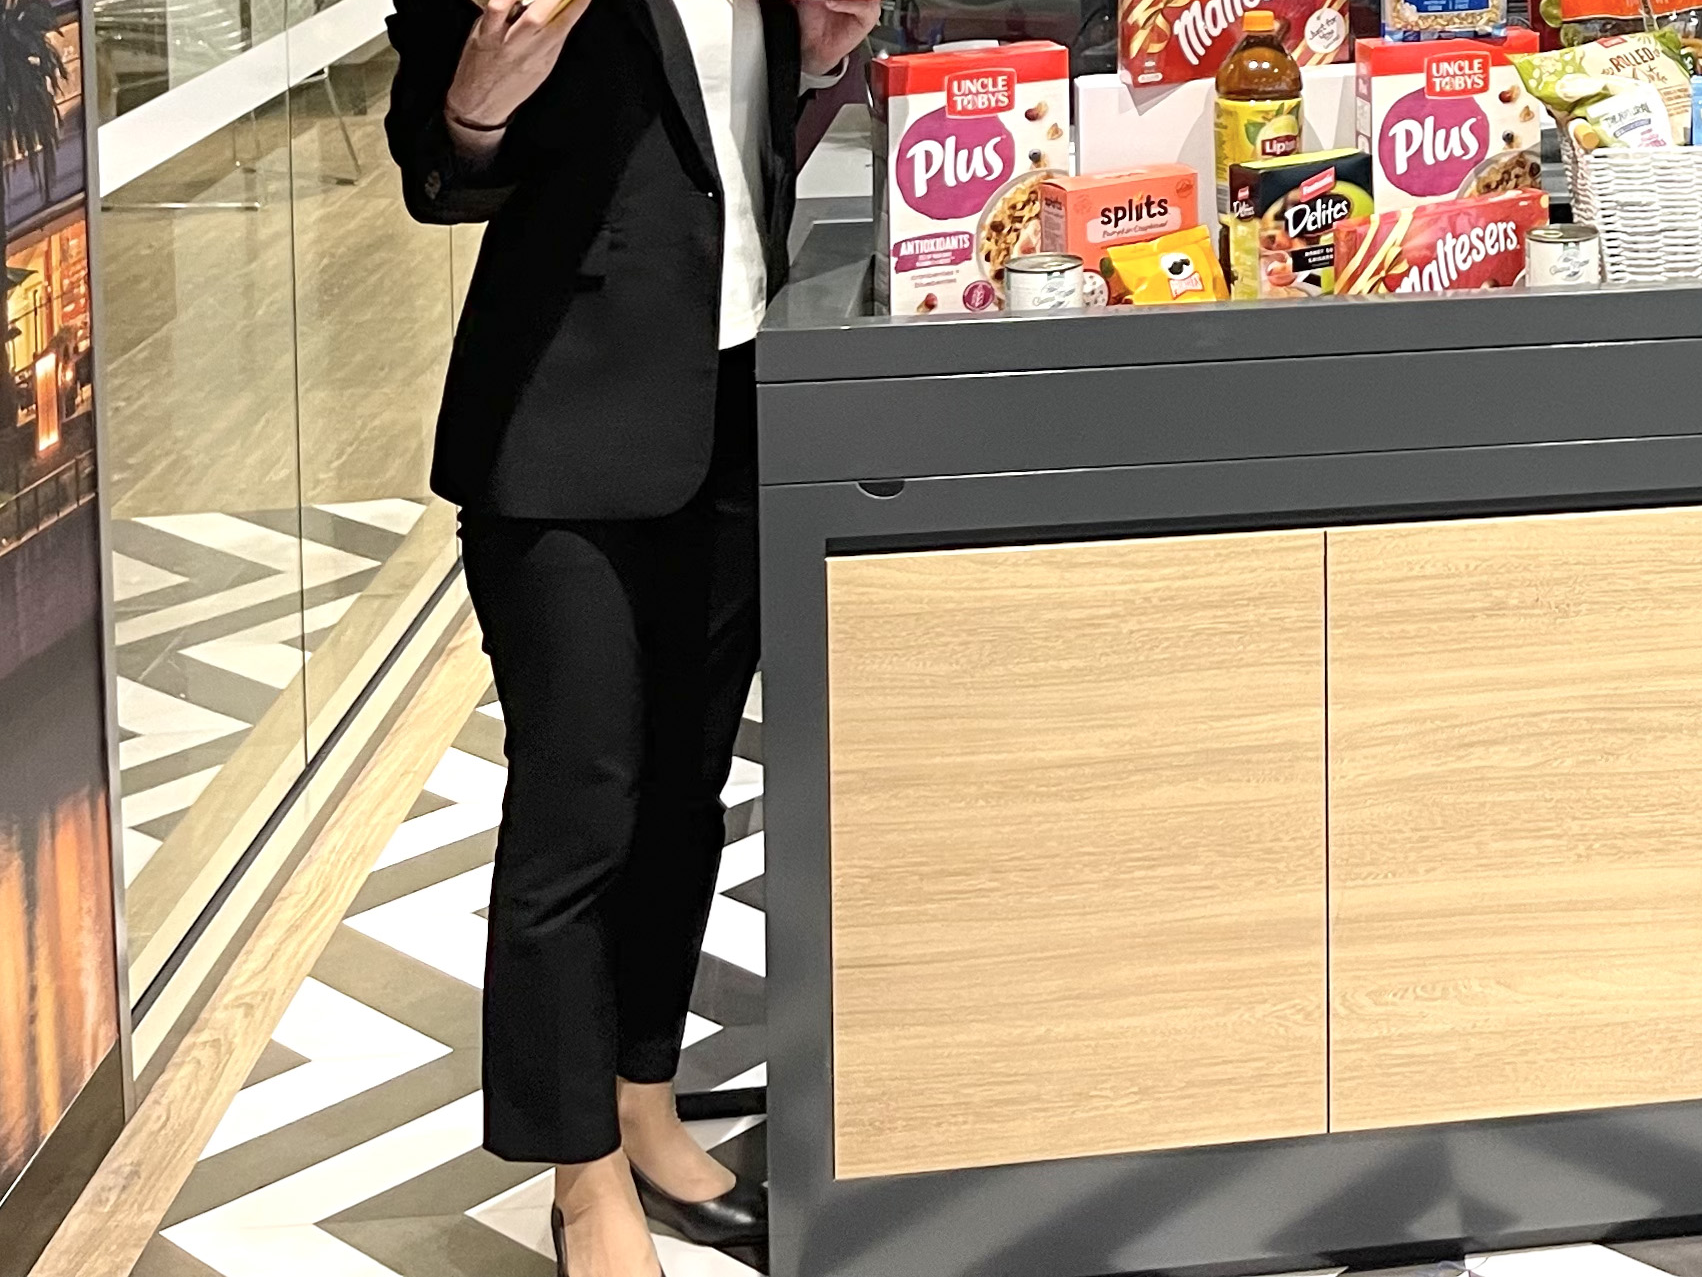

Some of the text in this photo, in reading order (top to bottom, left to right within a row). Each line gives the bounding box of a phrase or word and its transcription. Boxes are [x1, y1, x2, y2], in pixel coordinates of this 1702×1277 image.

[1432, 58, 1482, 75] UNCLE
[1609, 47, 1655, 72] ROLLED
[953, 75, 1007, 94] UNCLE
[1432, 75, 1484, 91] TOBYS
[953, 93, 1009, 111] TOBYS
[1388, 116, 1479, 175] Plus
[906, 135, 1003, 198] Plus
[1101, 191, 1168, 228] splits
[1285, 198, 1348, 238] Delites
[900, 233, 970, 255] ANTIOXIDANTS
